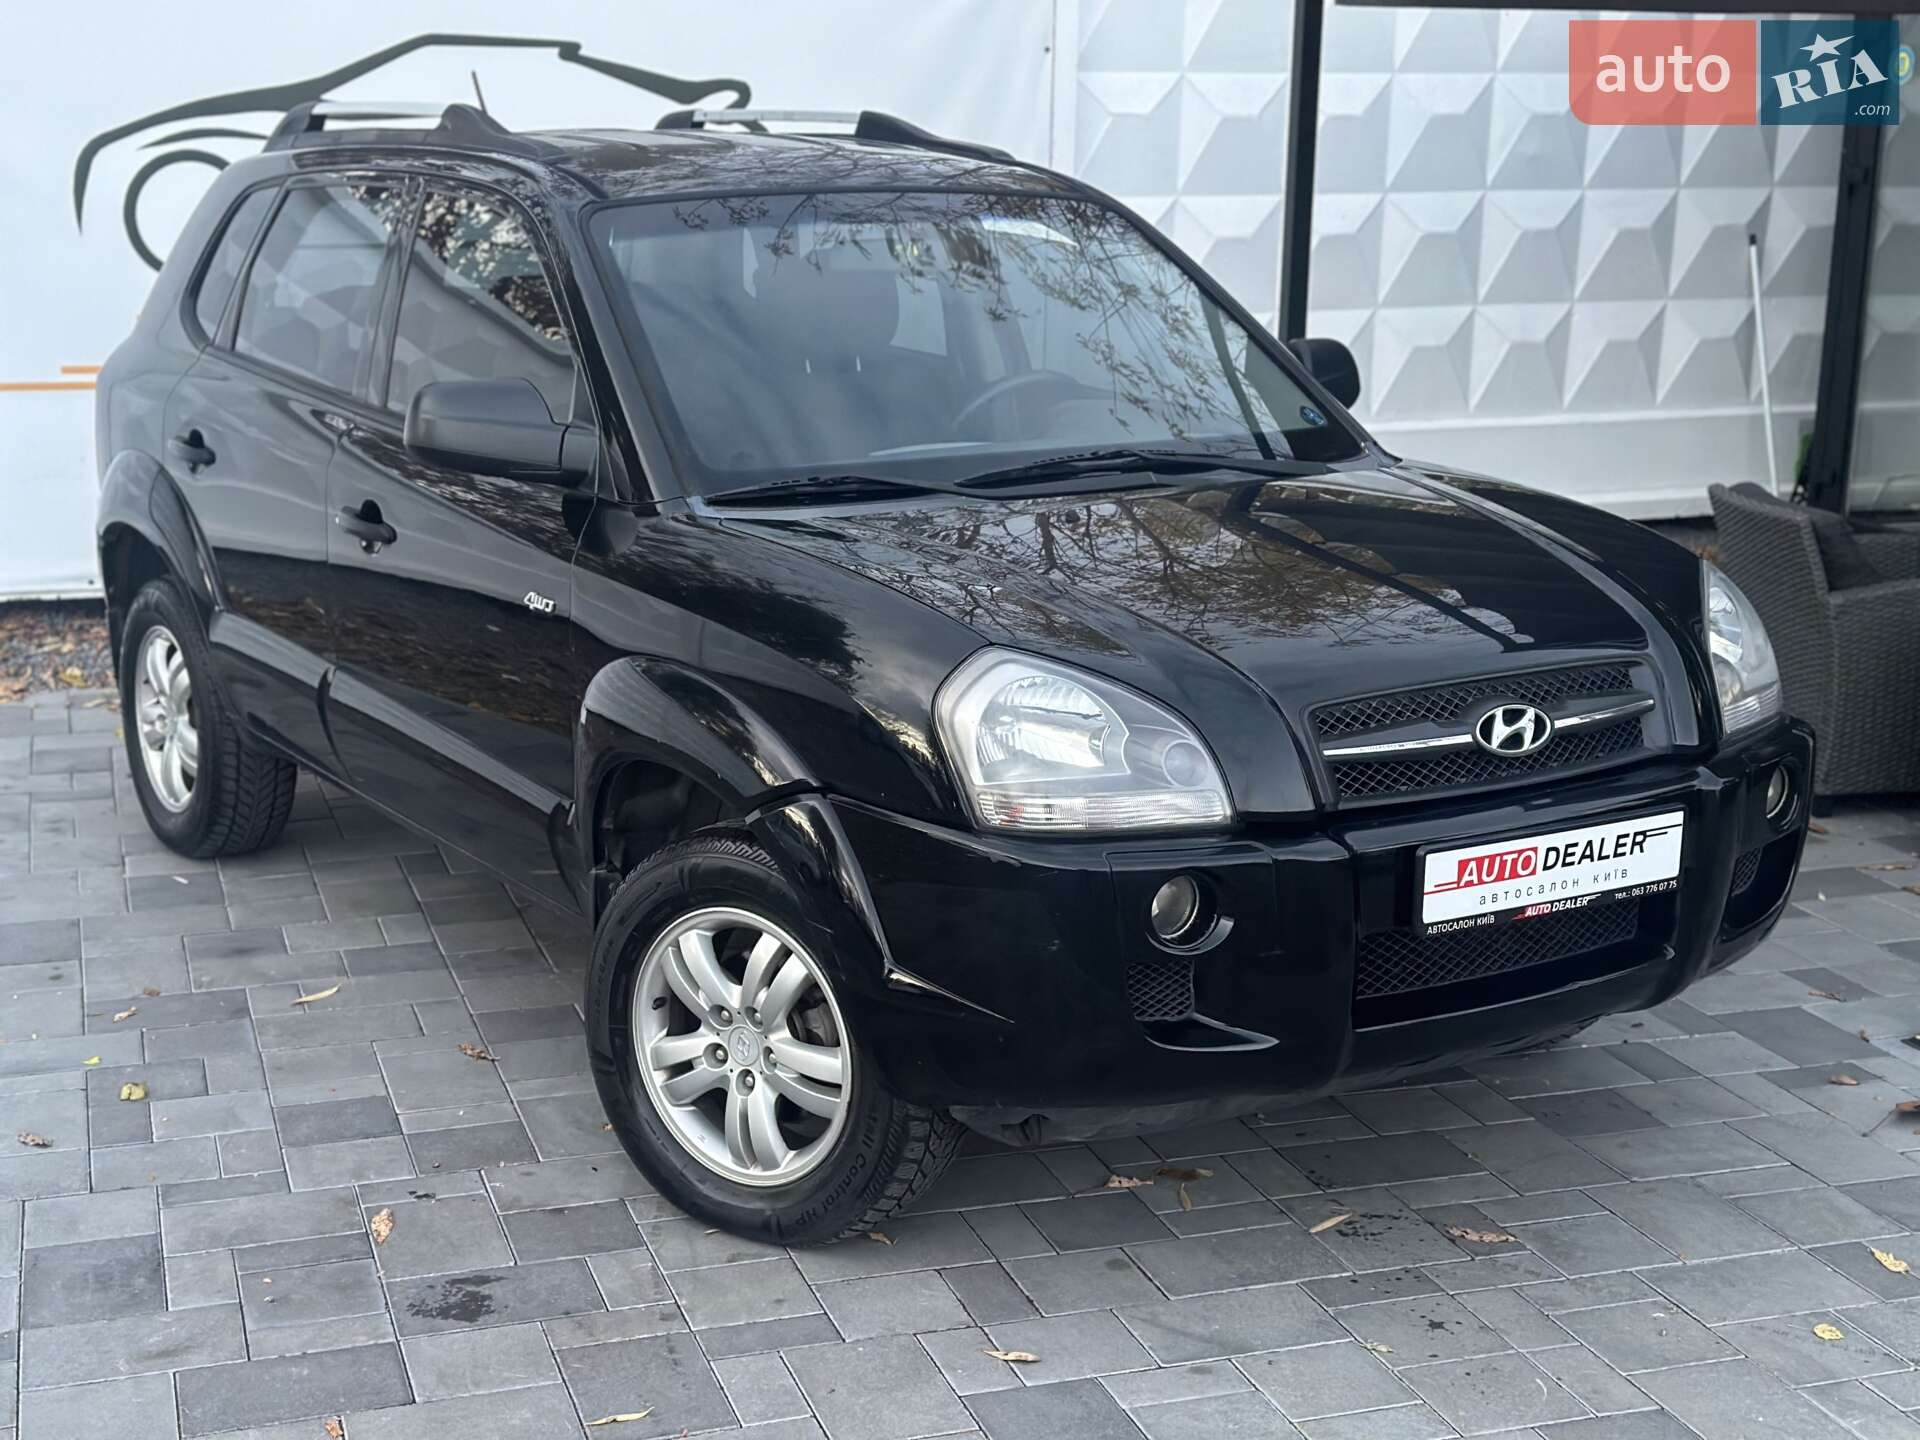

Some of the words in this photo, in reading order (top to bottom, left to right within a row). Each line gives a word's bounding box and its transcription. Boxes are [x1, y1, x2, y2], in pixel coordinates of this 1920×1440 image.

[1459, 850, 1537, 887] AUTO
[1542, 831, 1647, 871] DEALER
[1479, 880, 1580, 906] автосалон
[1525, 903, 1552, 917] AUTO
[1552, 895, 1590, 912] DEALER
[1426, 918, 1475, 936] АВТОСАЛОН
